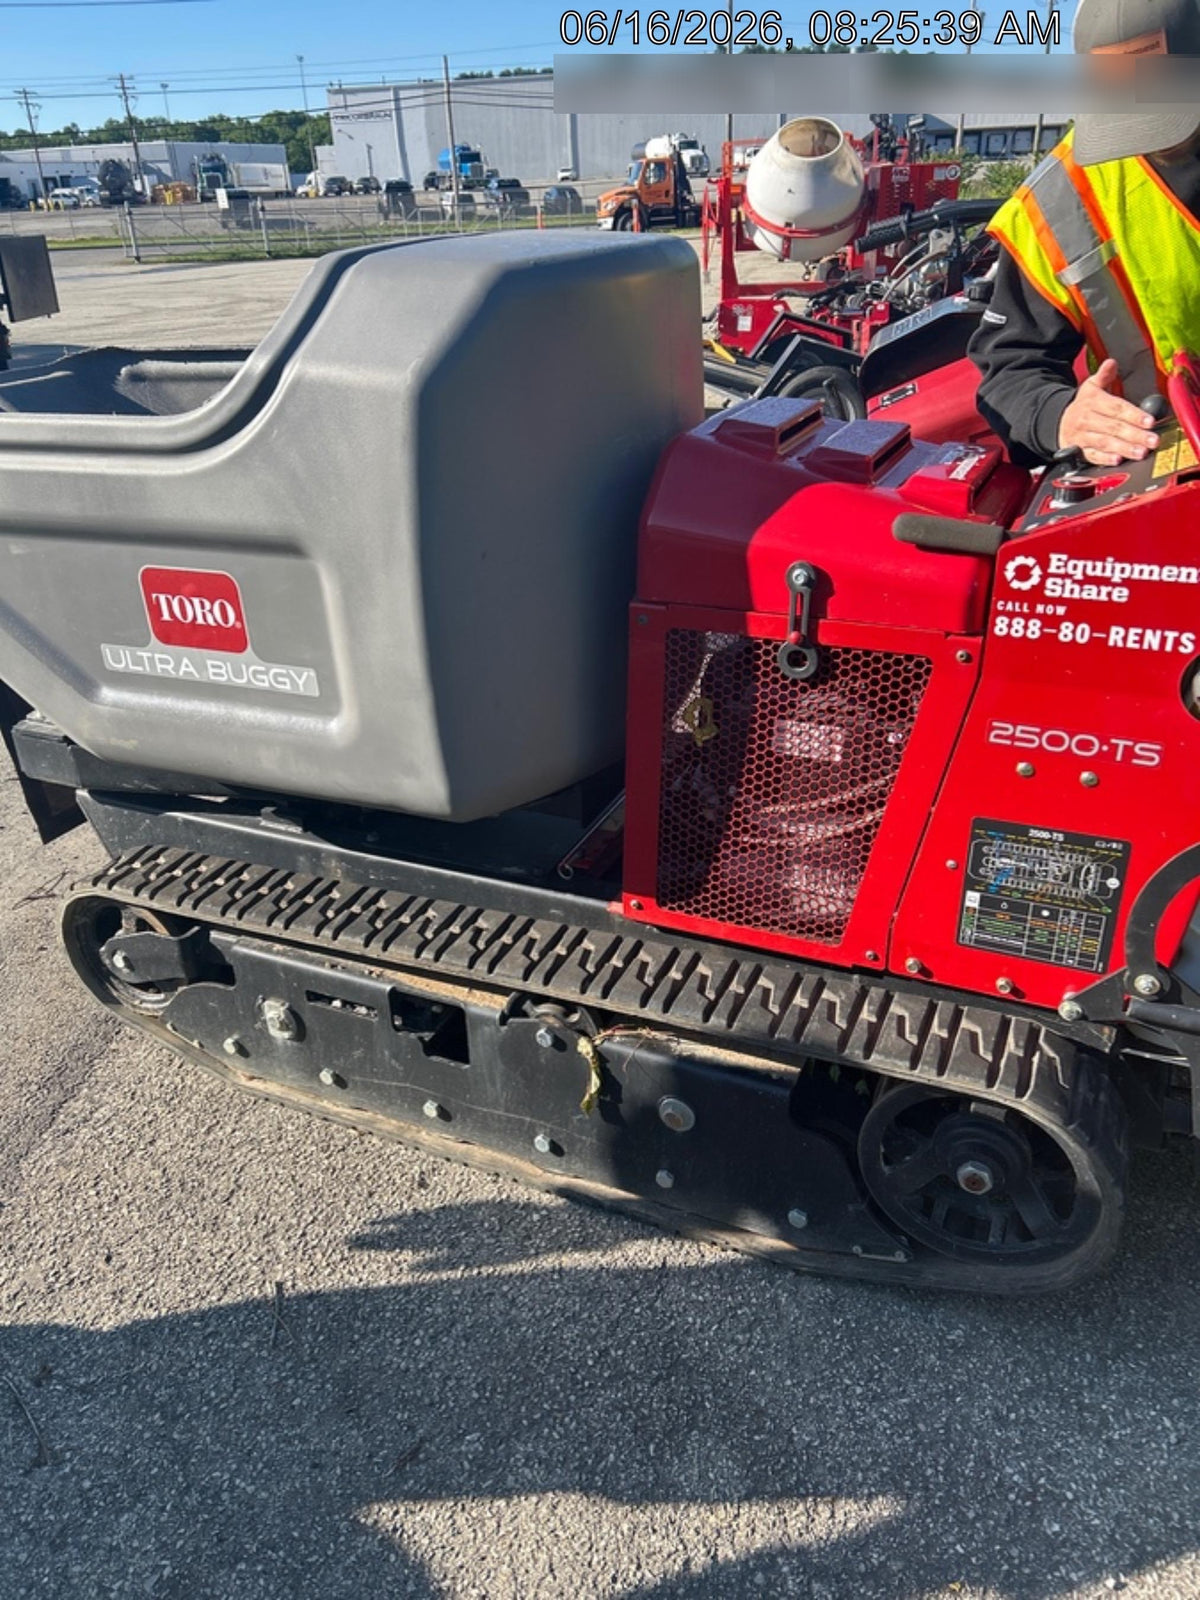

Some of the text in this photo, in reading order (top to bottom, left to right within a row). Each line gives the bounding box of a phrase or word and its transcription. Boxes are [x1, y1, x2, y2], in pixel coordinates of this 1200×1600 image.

[1047, 553, 1200, 584] Equipmen
[1044, 577, 1129, 603] Share
[152, 593, 236, 629] TORO
[996, 600, 1067, 616] CALL NOW
[993, 615, 1196, 654] 888-80-RENTS
[105, 648, 309, 691] ULTRA BUGGY
